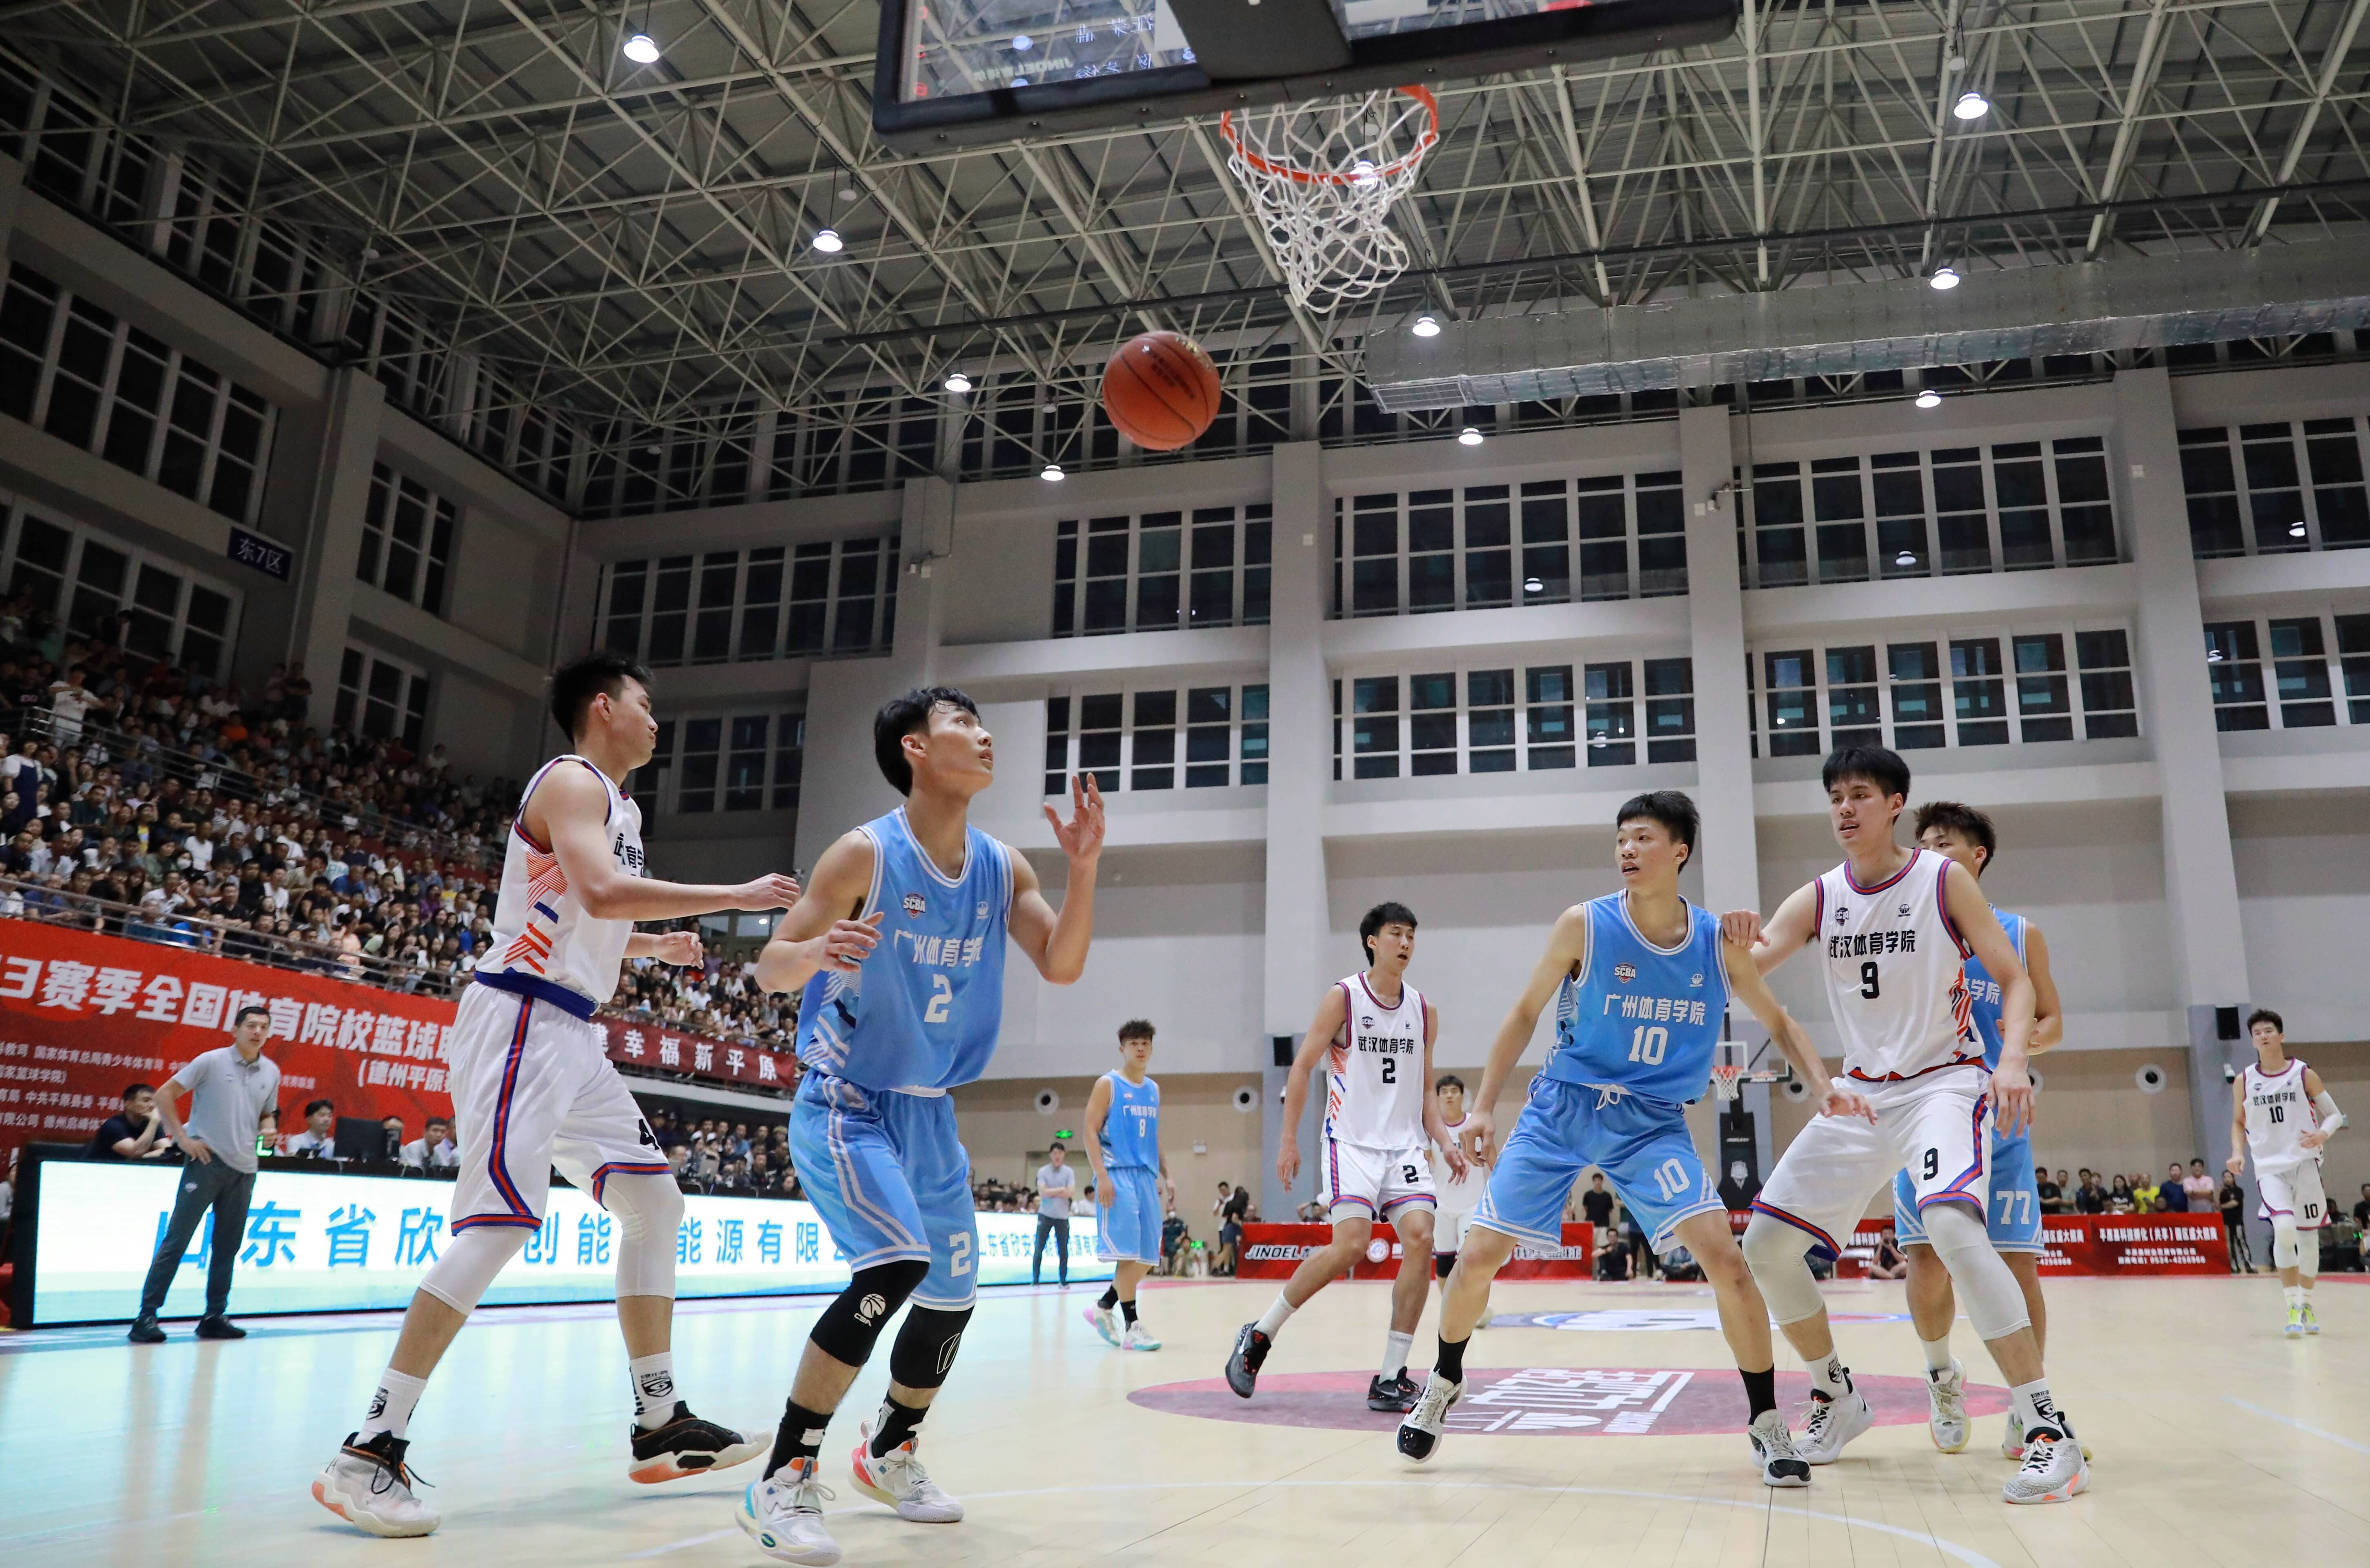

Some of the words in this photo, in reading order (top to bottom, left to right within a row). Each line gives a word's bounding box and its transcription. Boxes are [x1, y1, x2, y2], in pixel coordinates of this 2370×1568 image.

[903, 897, 926, 913] SCBA
[1830, 930, 1916, 958] 武汉体育学院
[1614, 966, 1636, 979] SCBA
[1860, 961, 1880, 999] 9
[0, 954, 454, 1064] 3赛季全国体育院校篮球
[924, 974, 953, 1023] 2
[1604, 994, 1706, 1026] 广州体育学院
[1358, 1036, 1414, 1054] 武汉体育学院
[1628, 1025, 1669, 1066] 10
[1382, 1058, 1396, 1084] 2
[2270, 1106, 2284, 1123] 10
[1403, 1164, 1419, 1183] 2
[1653, 1158, 1690, 1202] 10
[1923, 1148, 1939, 1181] 9
[1996, 1190, 2031, 1225] 77
[2304, 1203, 2319, 1219] 10
[949, 1231, 971, 1278] 2
